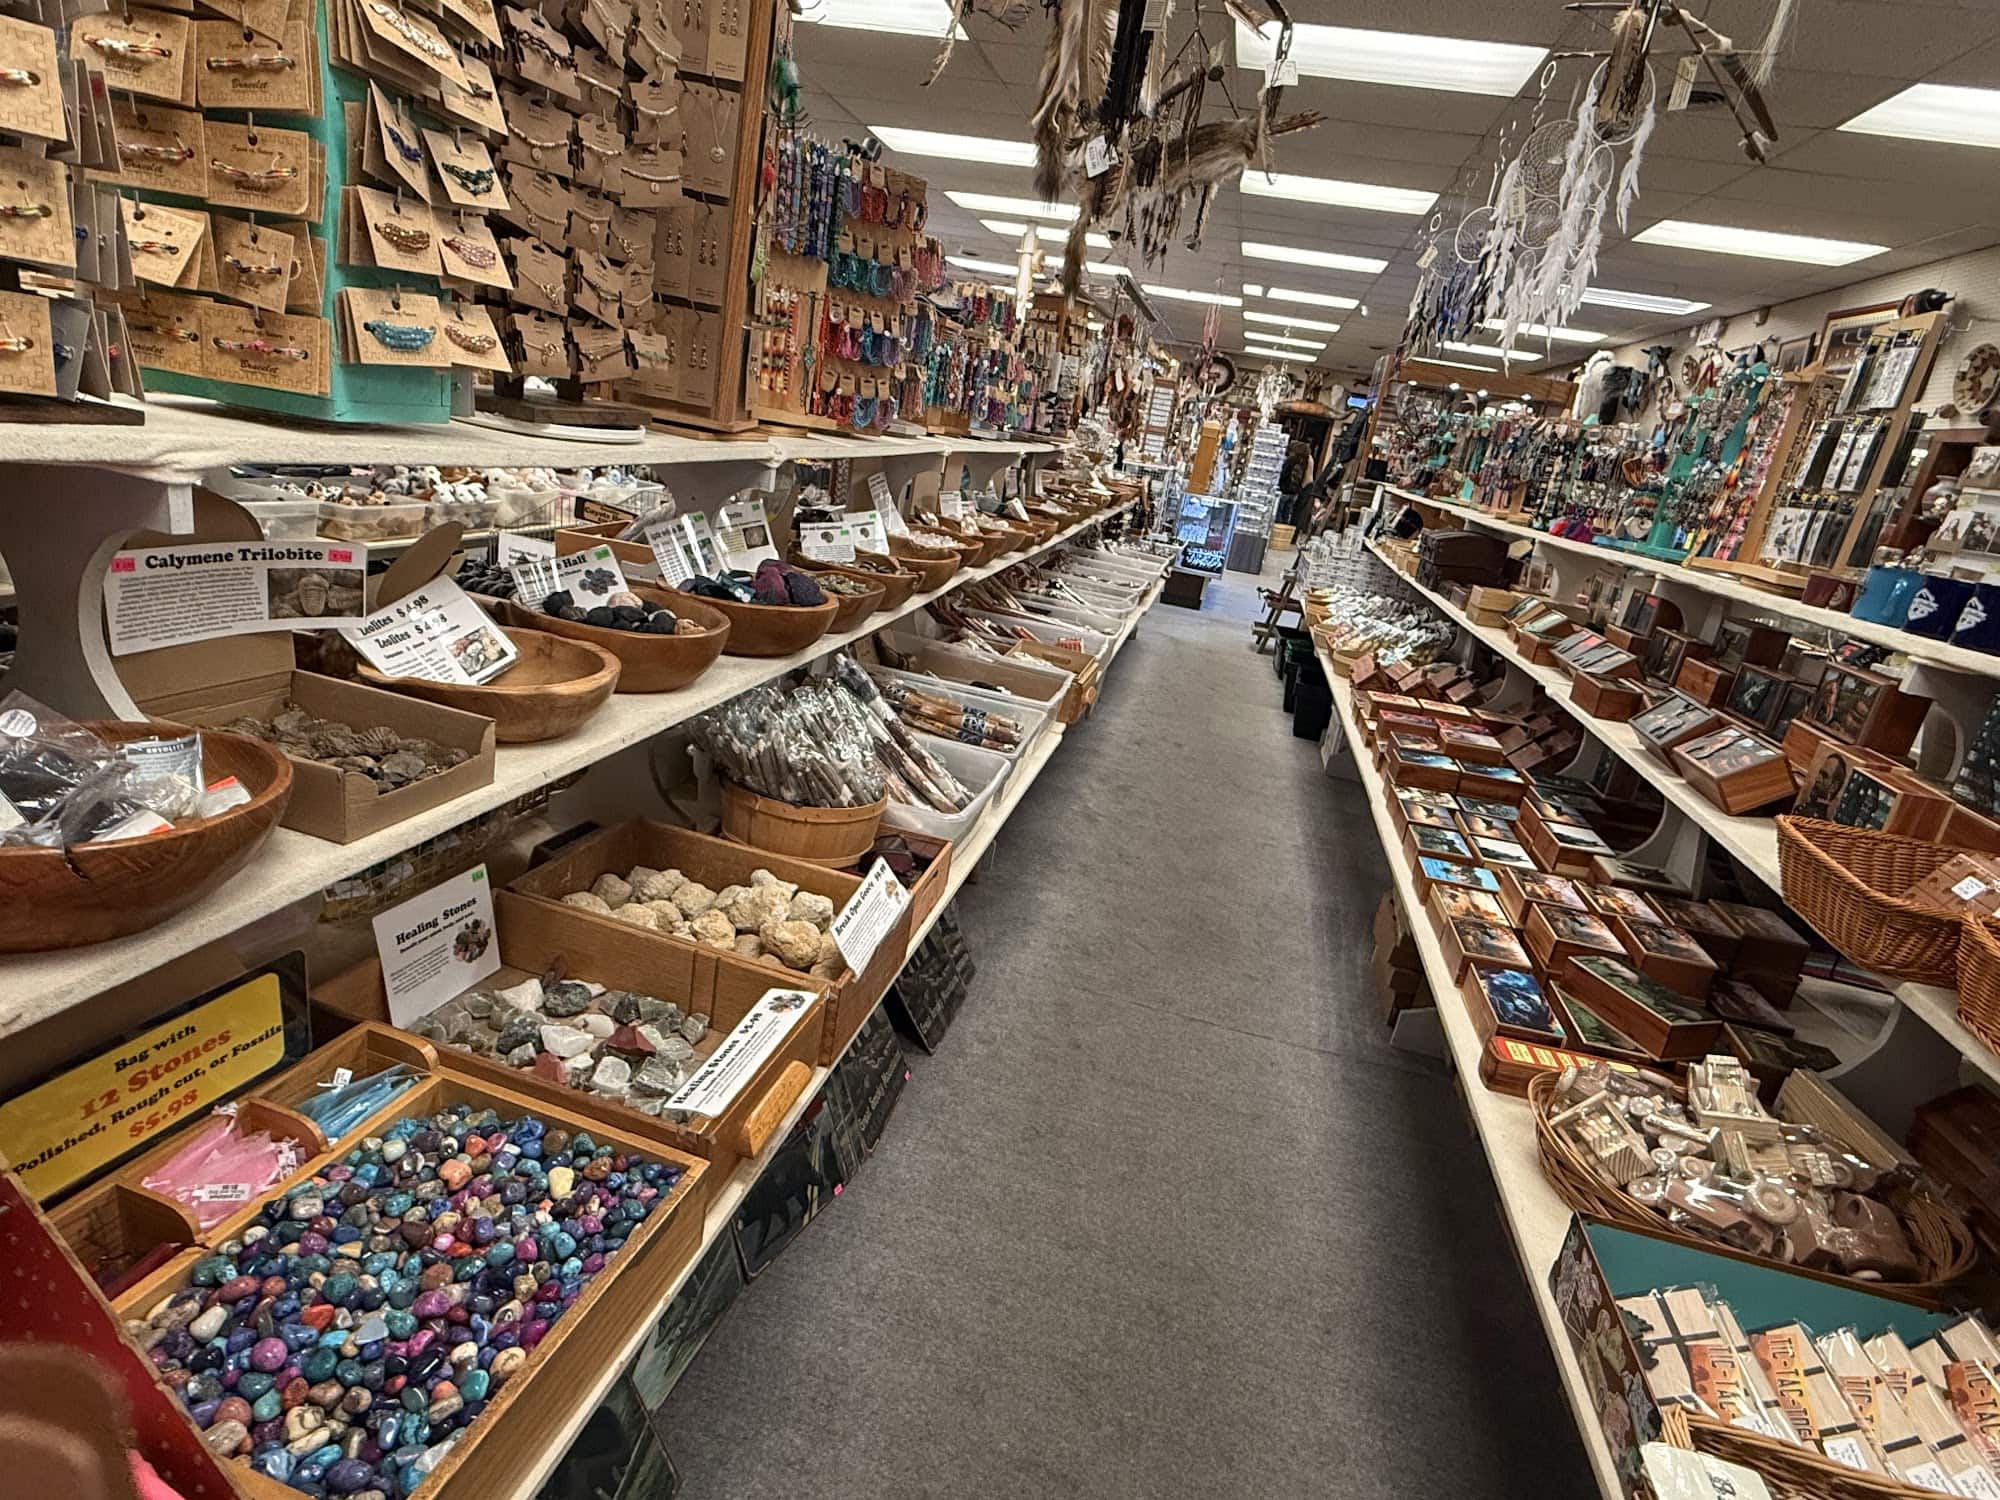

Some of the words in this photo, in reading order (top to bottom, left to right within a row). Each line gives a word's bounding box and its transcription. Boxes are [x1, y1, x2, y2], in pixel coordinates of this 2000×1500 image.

[144, 550, 235, 570] Calymene
[237, 547, 324, 562] Trilobite
[562, 554, 588, 568] Half
[357, 614, 395, 636] Zeolites
[374, 630, 412, 649] Zeolites
[394, 916, 440, 946] Healing
[442, 897, 478, 920] Stones
[849, 898, 863, 917] Open
[114, 1048, 150, 1073] Bag
[152, 1024, 197, 1051] with
[672, 1069, 715, 1105] Healing
[707, 1039, 740, 1069] Stones
[80, 1088, 121, 1120] 12
[127, 1029, 232, 1093] Stones
[12, 1123, 107, 1176] Polished,
[110, 1086, 170, 1125] Rough
[174, 1067, 206, 1089] cut,
[209, 1053, 229, 1069] or
[231, 1024, 282, 1057] Fossils
[128, 1088, 199, 1138] $5.98
[1769, 1337, 1813, 1437] TIC-TAC-TOE
